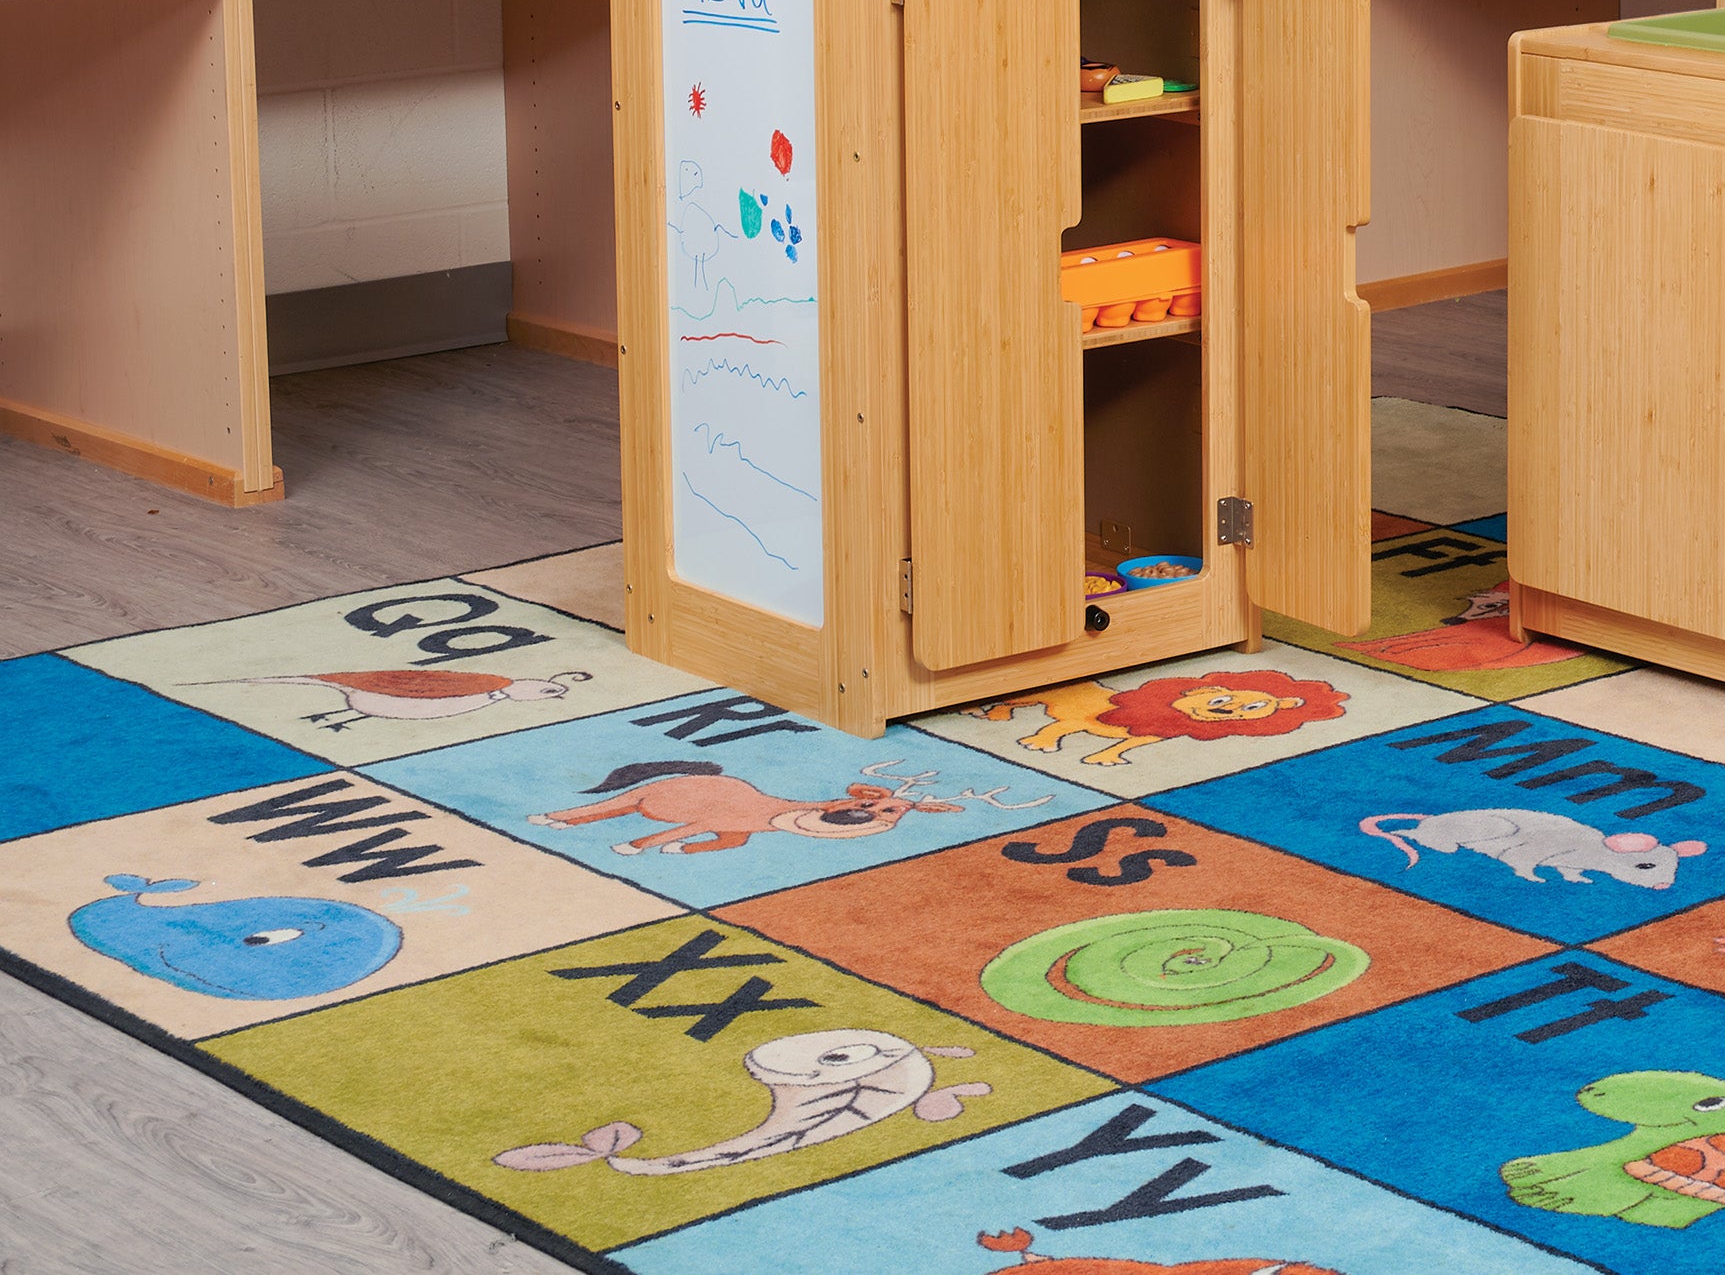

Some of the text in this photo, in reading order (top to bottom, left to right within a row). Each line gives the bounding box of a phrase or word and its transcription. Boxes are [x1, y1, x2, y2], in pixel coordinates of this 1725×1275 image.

[344, 592, 554, 666] Qq
[628, 695, 822, 747] Rr
[1386, 719, 1707, 820] Mm
[207, 778, 484, 884] Ww
[1001, 816, 1198, 887] Ss
[547, 931, 824, 1042] Xx
[1457, 961, 1677, 1044] Tt
[1001, 1103, 1288, 1231] Yy
